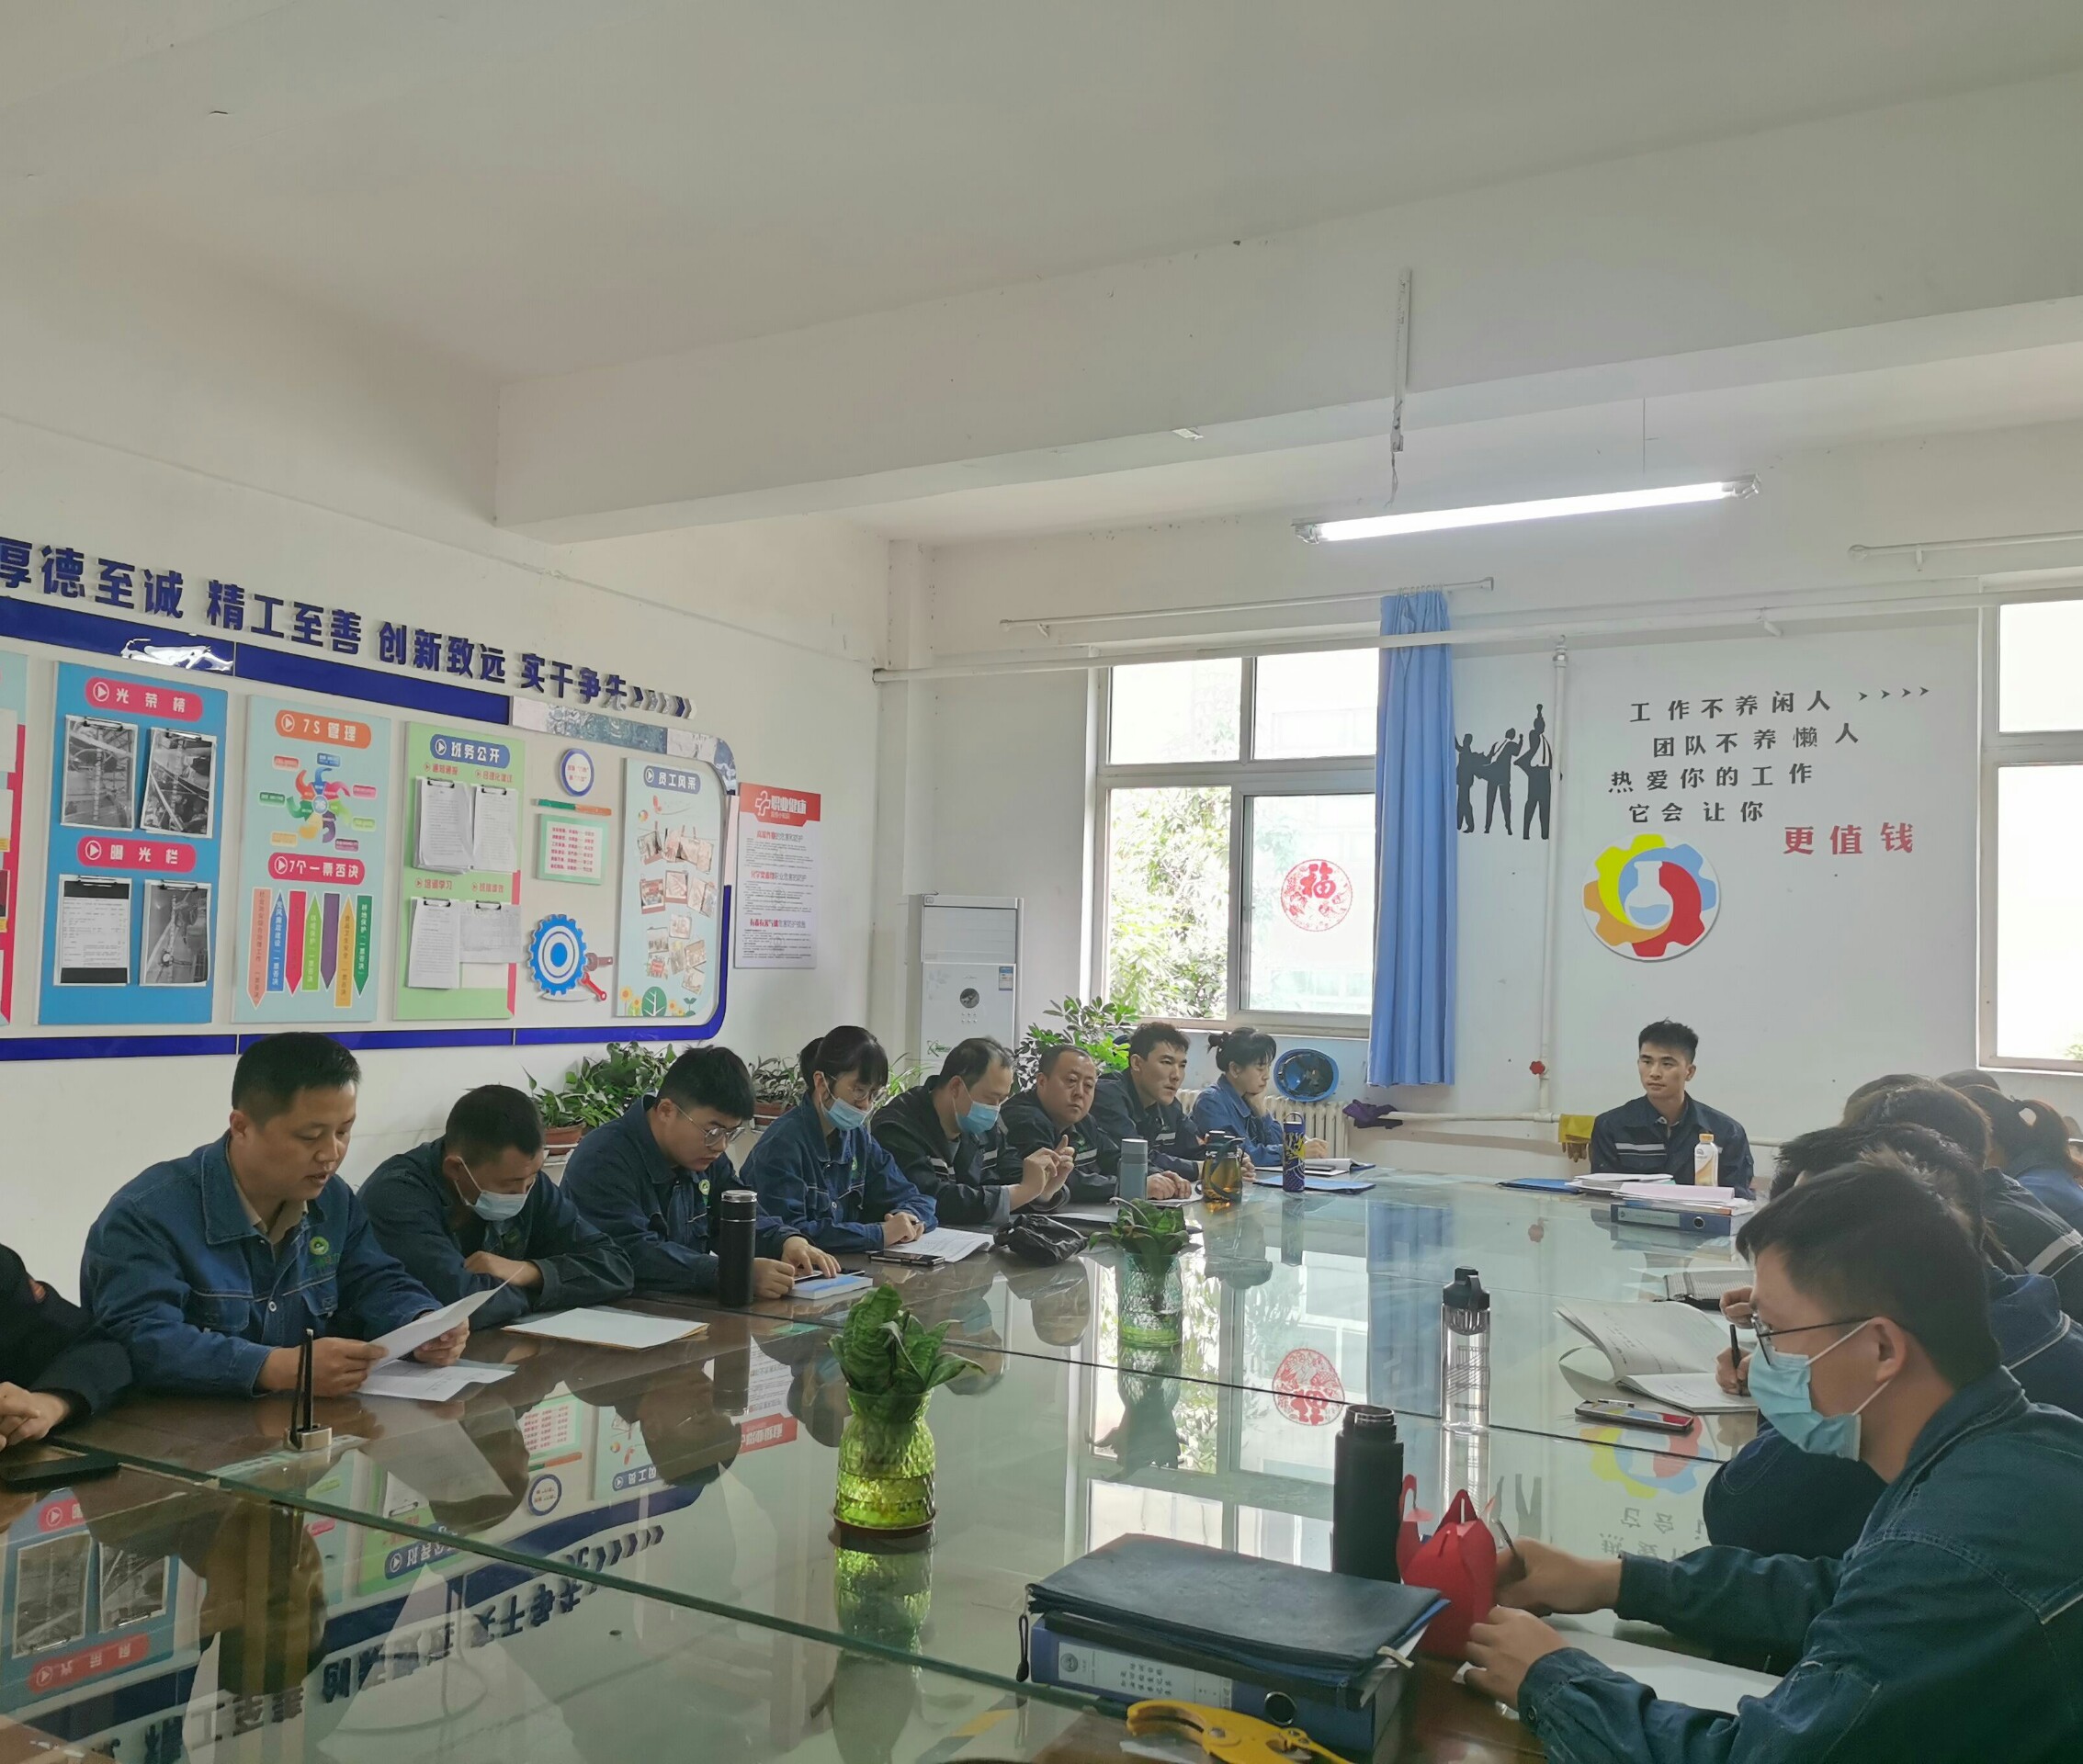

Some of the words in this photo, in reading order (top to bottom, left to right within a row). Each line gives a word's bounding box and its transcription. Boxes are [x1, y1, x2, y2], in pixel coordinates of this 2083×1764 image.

[0, 537, 184, 619] 厚德至诚
[207, 580, 362, 655] 精工至善
[378, 622, 506, 684] 创新致远
[519, 653, 628, 712] 实干争先
[116, 688, 186, 713] 光荣榜
[1629, 690, 1831, 723] 工作不养闲人
[451, 741, 500, 763] 班务公开
[1652, 722, 1860, 758] 团队不养懒人
[658, 773, 696, 790] 员工风采
[1608, 763, 1814, 795] 热爱你的工作
[1628, 800, 1764, 824] 它会让你
[1783, 821, 1915, 856] 更值钱
[289, 860, 359, 879] 7个一票否决
[1299, 861, 1337, 899] 福
